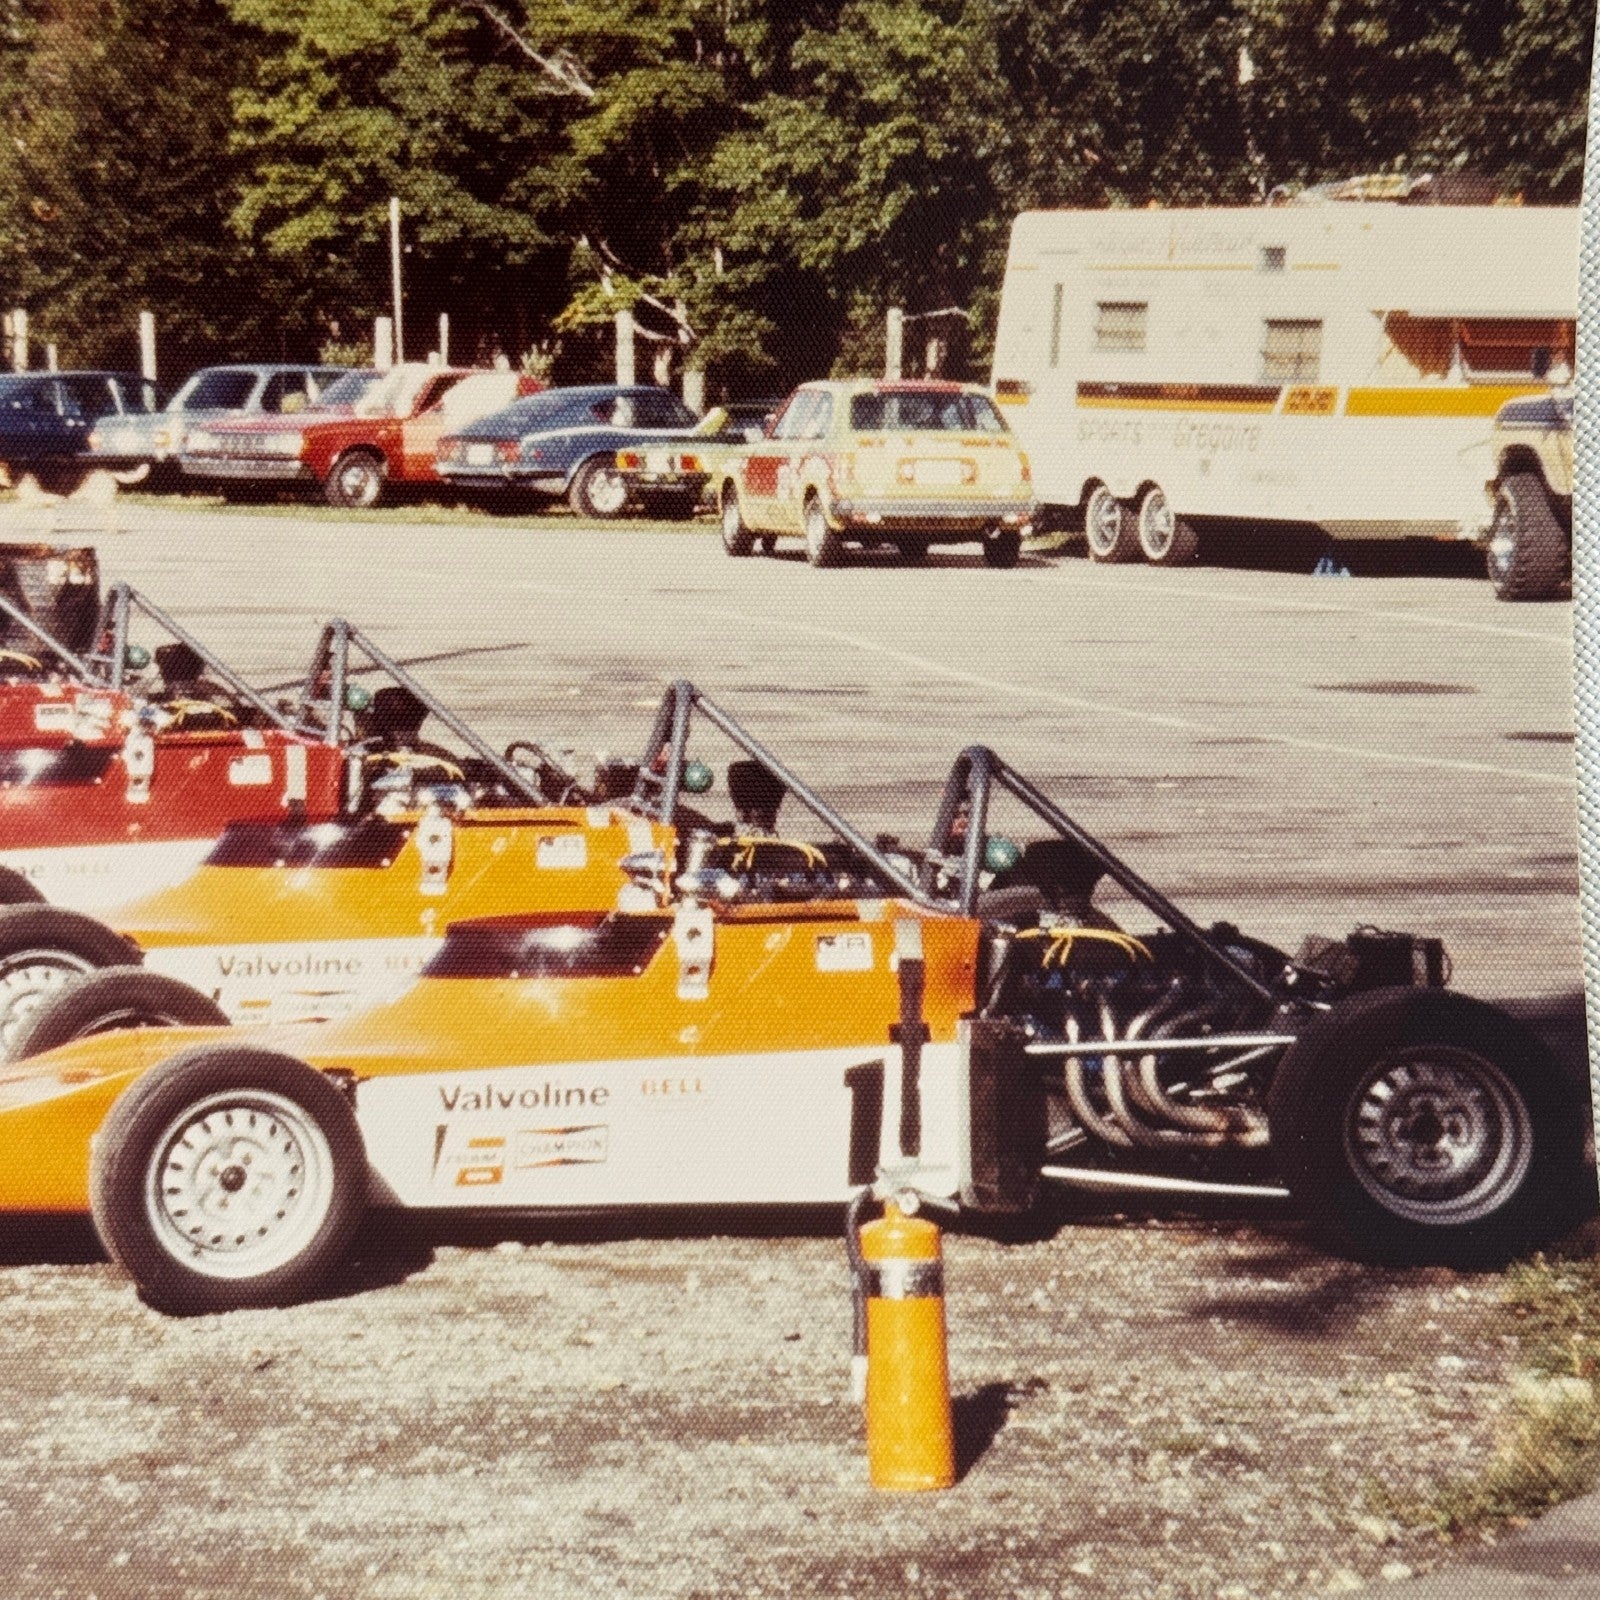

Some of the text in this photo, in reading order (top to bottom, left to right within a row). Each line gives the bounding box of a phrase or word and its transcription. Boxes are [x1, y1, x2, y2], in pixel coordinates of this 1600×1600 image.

[218, 954, 361, 977] Valvoline
[439, 1082, 611, 1112] Valvoline
[640, 1077, 704, 1096] BELL
